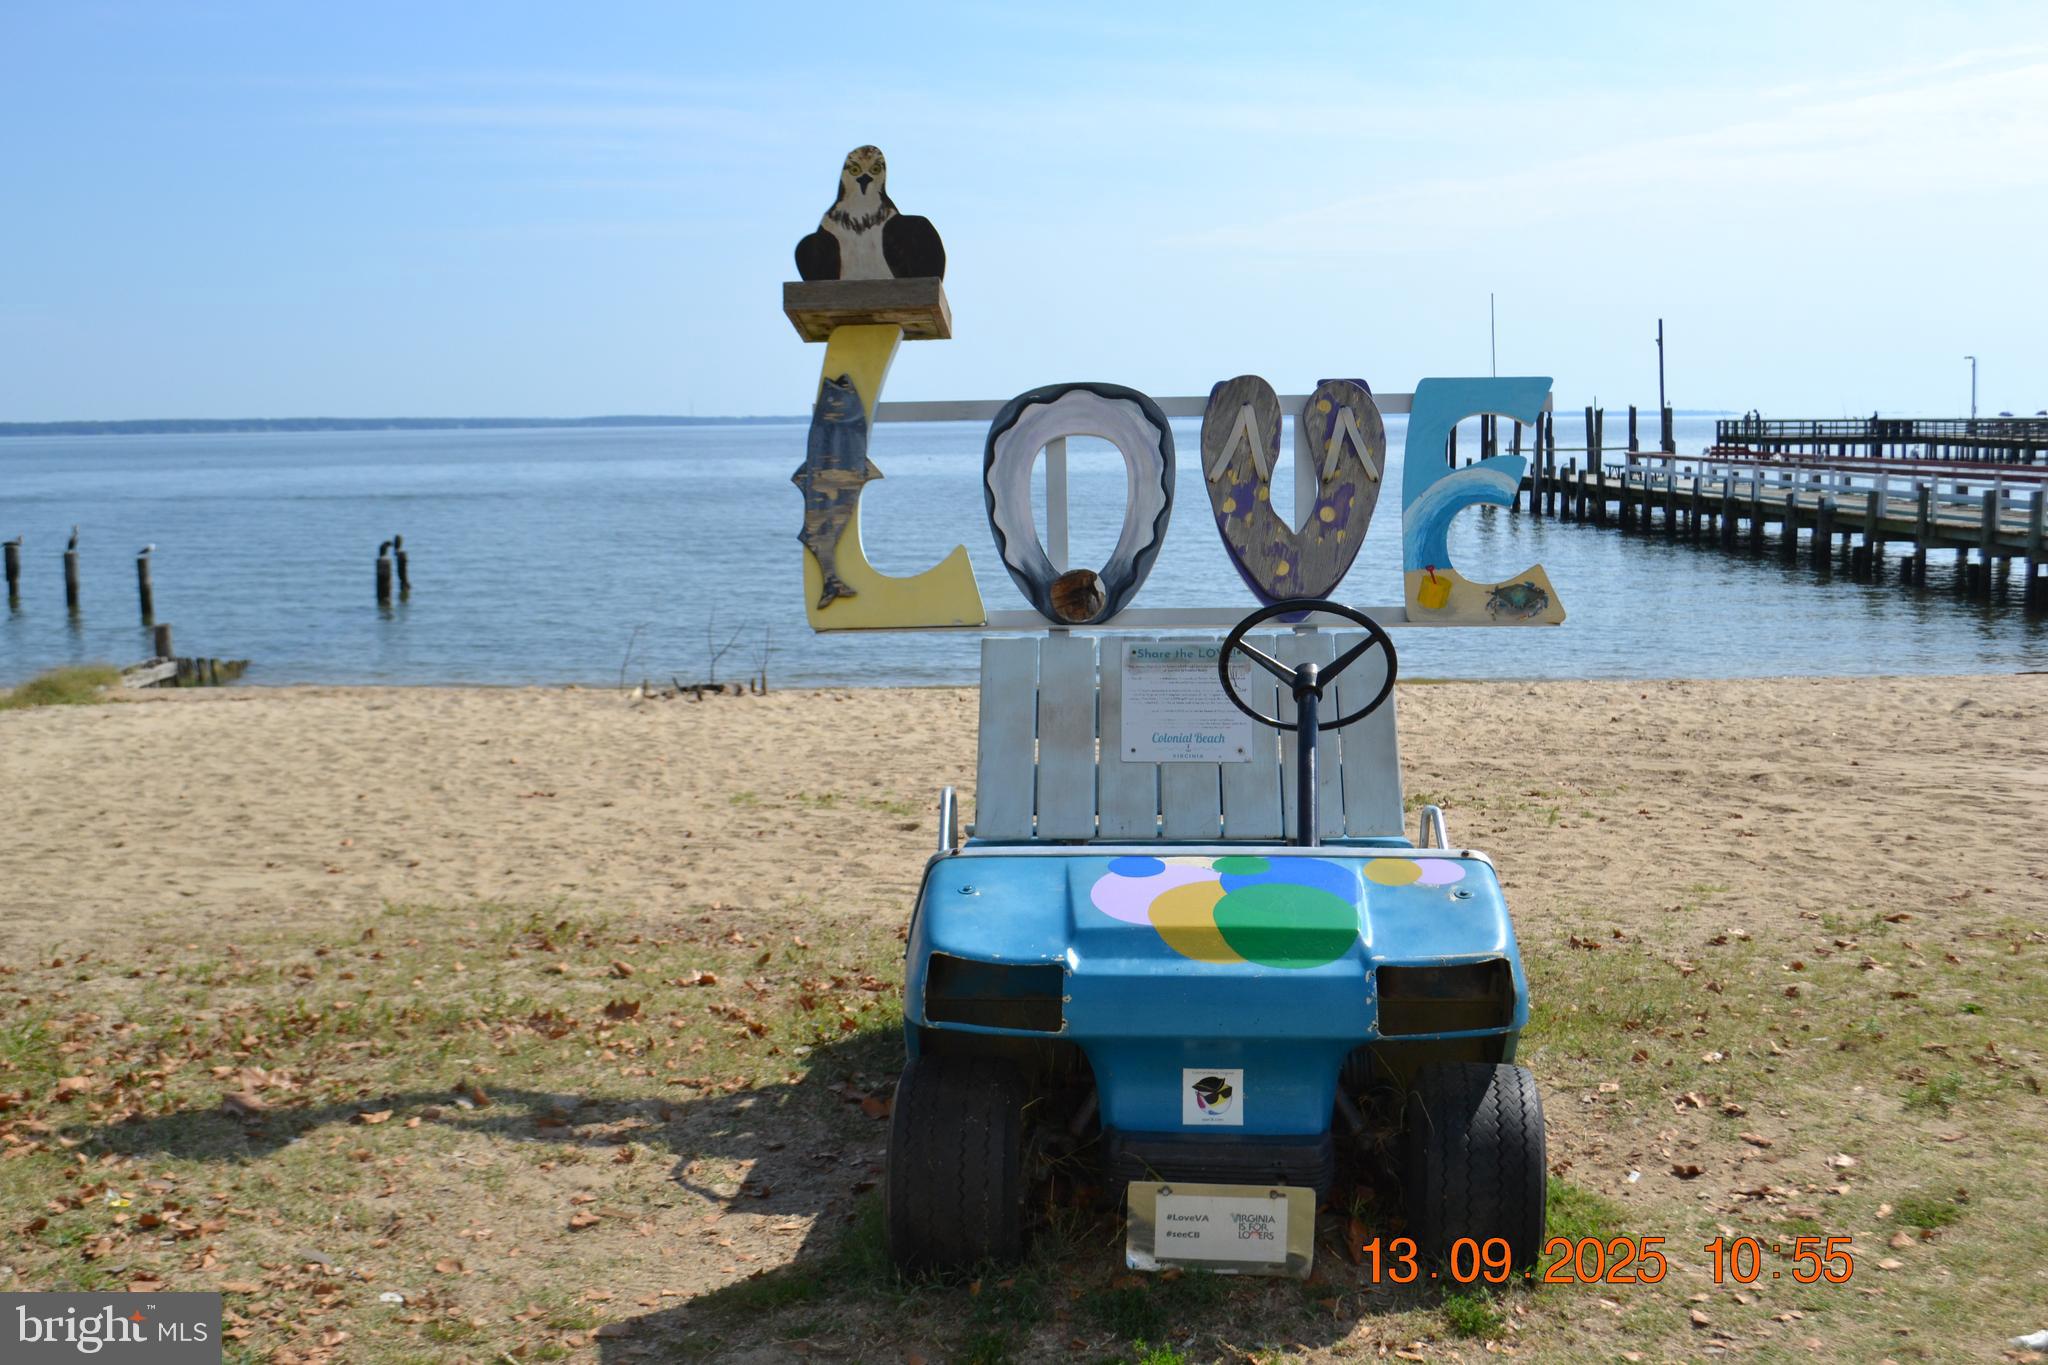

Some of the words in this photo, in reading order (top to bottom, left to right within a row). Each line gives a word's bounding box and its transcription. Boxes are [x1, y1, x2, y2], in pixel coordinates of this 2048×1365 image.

[803, 325, 1566, 632] LOVE
[1137, 648, 1170, 659] Share
[1175, 648, 1194, 659] the
[1151, 732, 1193, 744] Colonial
[1194, 733, 1225, 744] Beach
[1166, 1213, 1209, 1223] #LoveVA
[1231, 1213, 1275, 1224] VIRGINIA
[1238, 1223, 1246, 1231] IS
[1248, 1223, 1268, 1231] FOR
[1166, 1230, 1201, 1239] #seeCB
